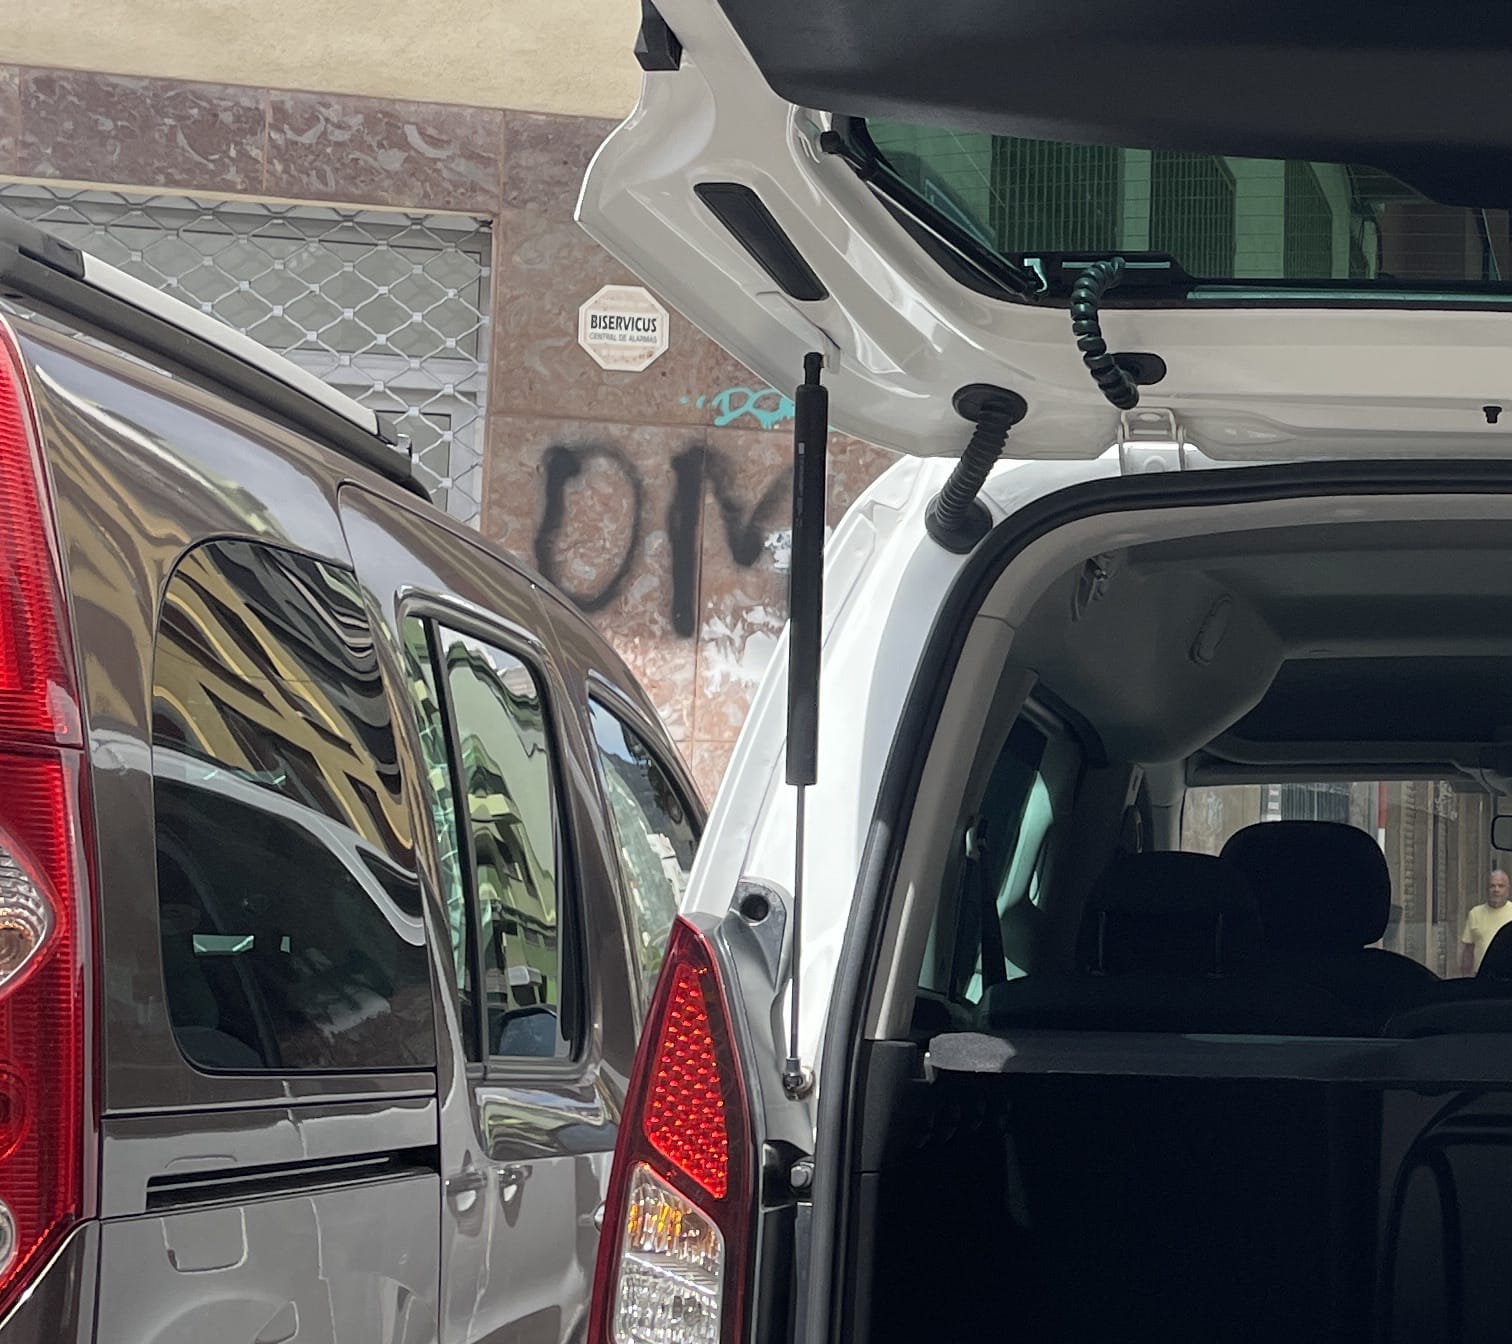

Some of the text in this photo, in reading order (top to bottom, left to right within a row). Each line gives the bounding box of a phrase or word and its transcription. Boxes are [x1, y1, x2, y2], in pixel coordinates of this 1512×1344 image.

[590, 314, 657, 333] BISERVICUS
[589, 332, 617, 342] CENTRAL
[628, 336, 658, 344] ALARMAS
